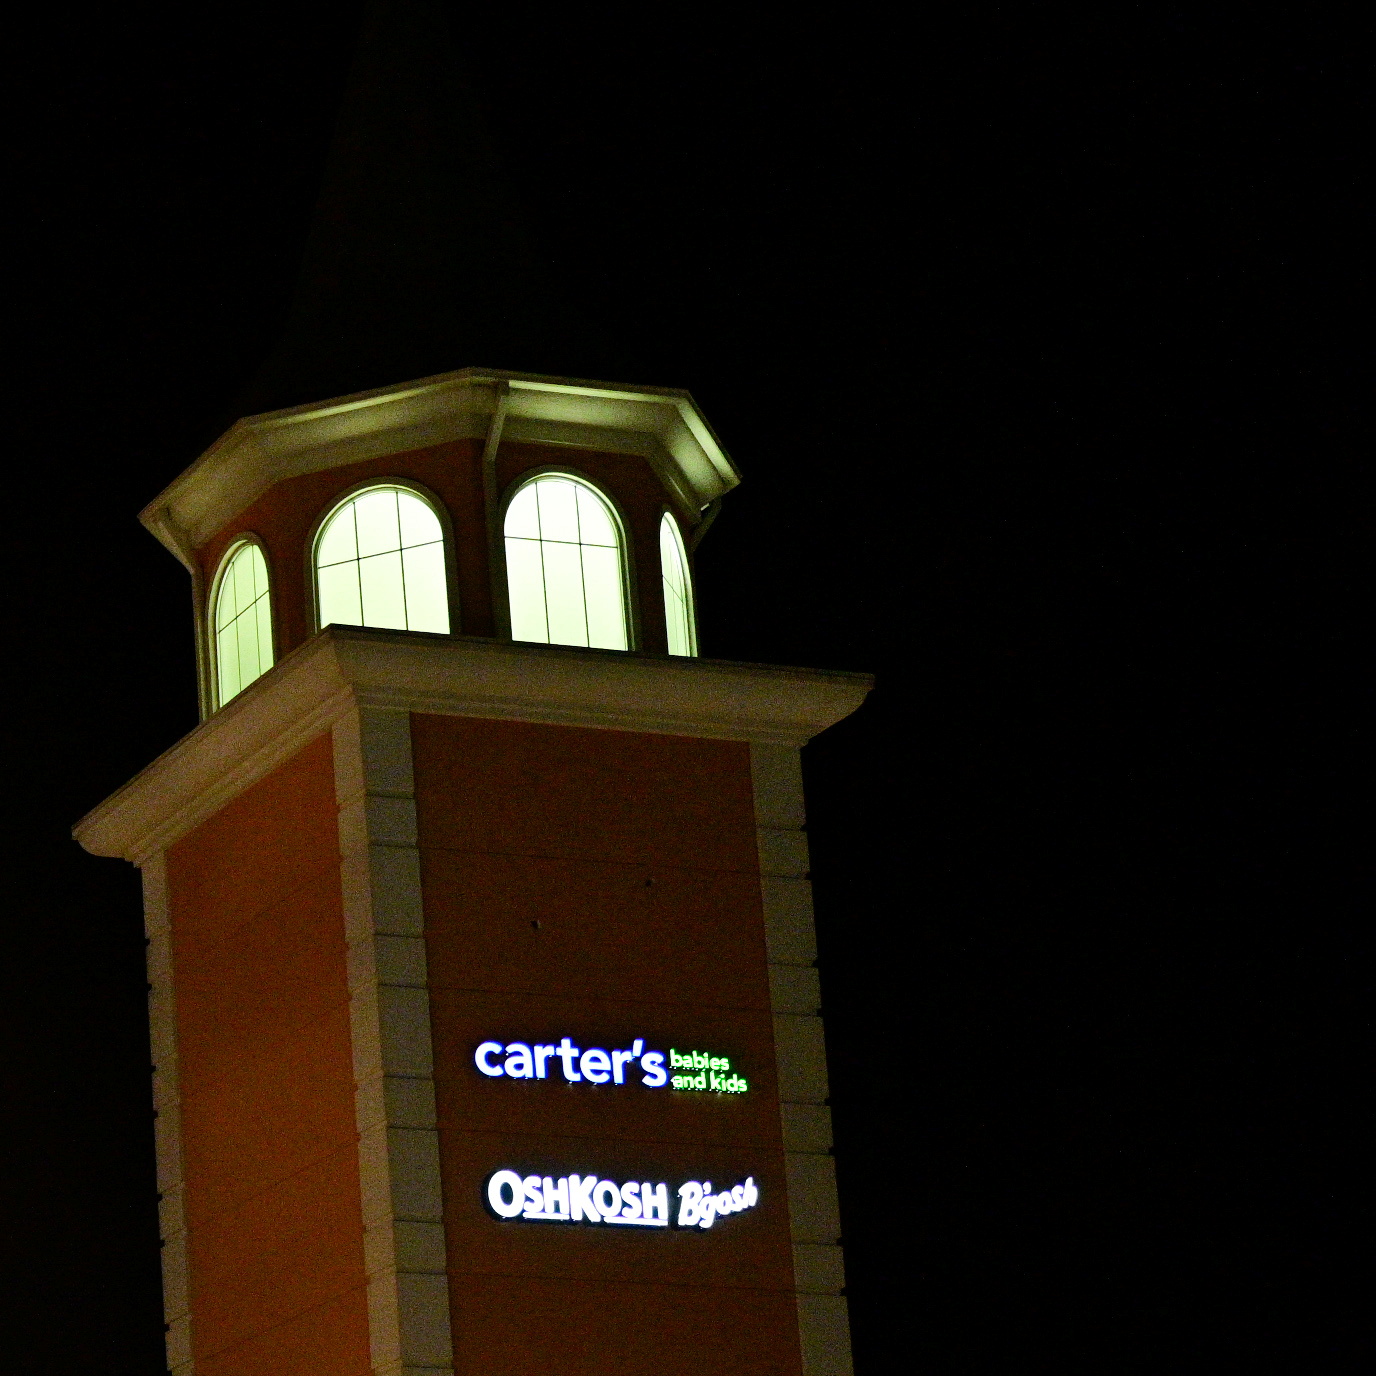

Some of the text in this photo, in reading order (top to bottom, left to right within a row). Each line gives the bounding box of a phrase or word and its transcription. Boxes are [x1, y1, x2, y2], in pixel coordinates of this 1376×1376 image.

[474, 1038, 668, 1088] carter's
[669, 1048, 730, 1071] babies
[672, 1070, 748, 1094] and kids
